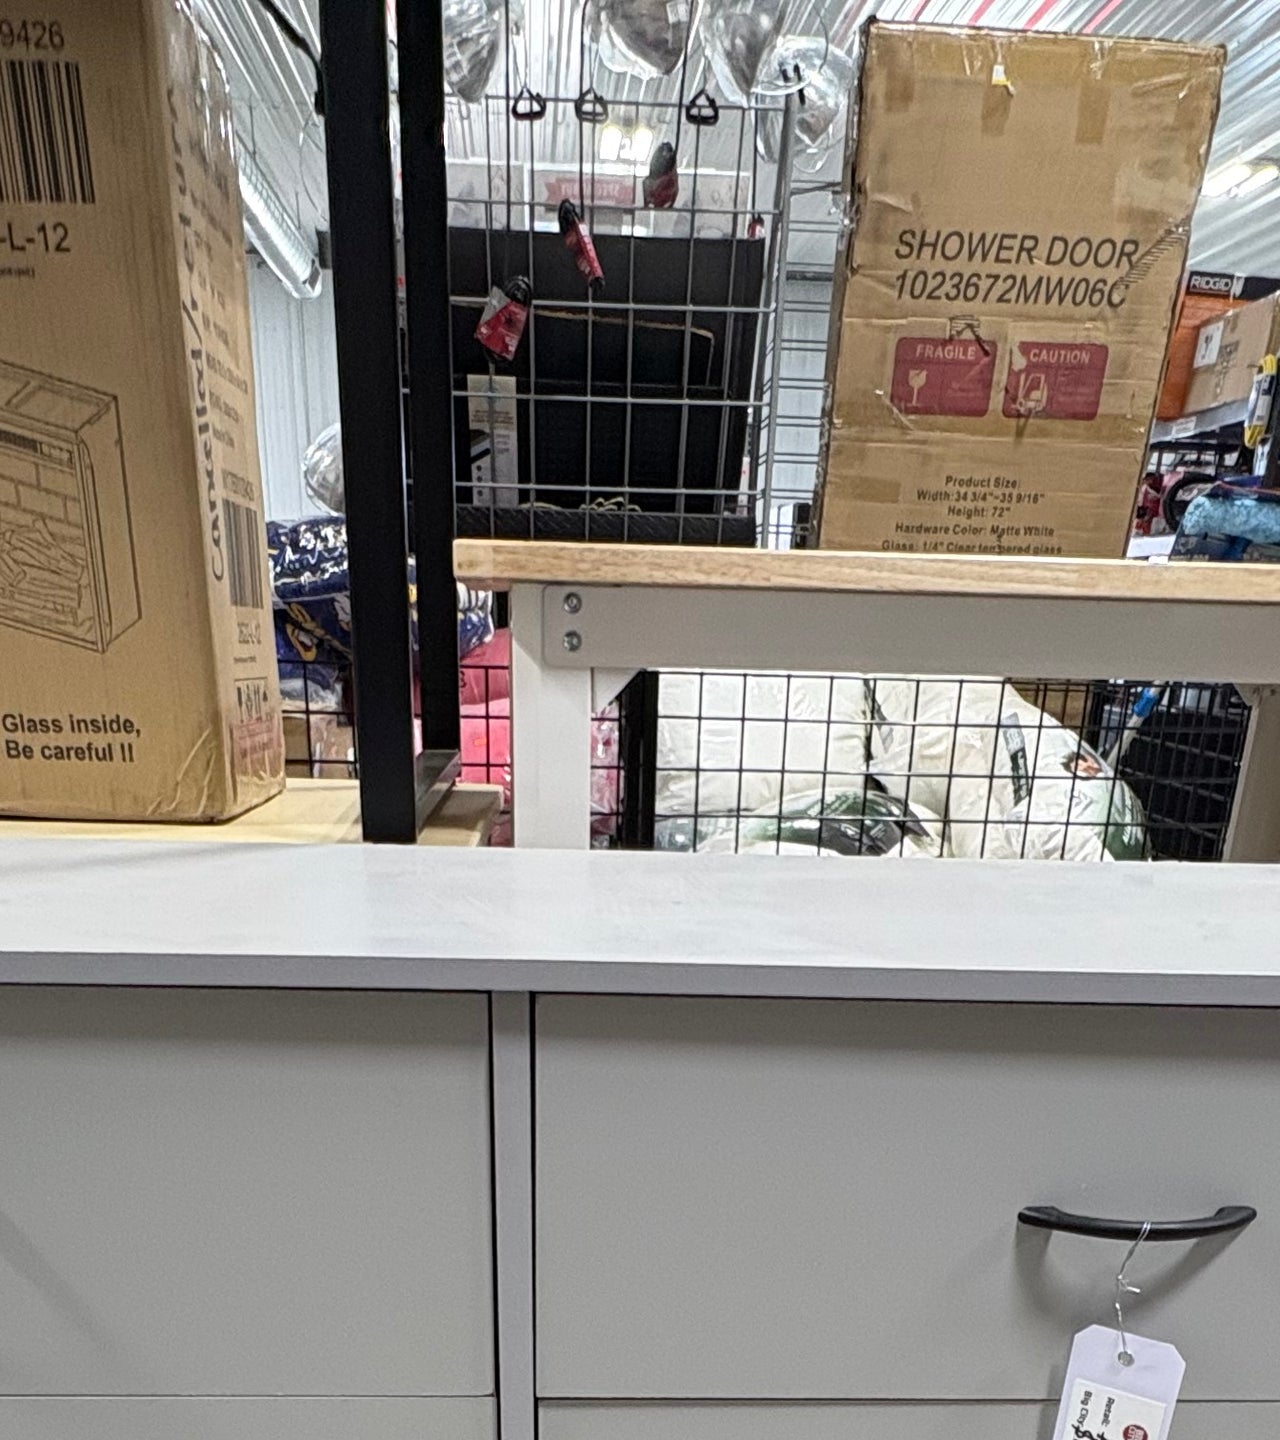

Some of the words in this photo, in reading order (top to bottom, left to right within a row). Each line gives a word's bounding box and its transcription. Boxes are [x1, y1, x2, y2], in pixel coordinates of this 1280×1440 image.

[895, 229, 1039, 264] SHOWER
[1044, 236, 1140, 271] DOOR
[895, 269, 1131, 309] 1023672MW06C
[1190, 275, 1232, 291] RIDGID
[915, 344, 976, 361] FRAGILE
[1029, 349, 1091, 365] CAUTION
[944, 475, 991, 491] Product
[947, 505, 988, 520] Height:
[991, 506, 1011, 519] 72"
[895, 522, 950, 536] Hardware
[952, 523, 987, 537] Color:
[990, 524, 1020, 538] Matte
[1023, 525, 1055, 538] White
[946, 542, 976, 553] Clear
[1, 713, 64, 734] Glass
[68, 713, 141, 738] inside,
[5, 739, 34, 760] Be
[40, 742, 114, 762] careful
[1080, 1390, 1093, 1407] Big
[1100, 1396, 1116, 1428] Retail:
